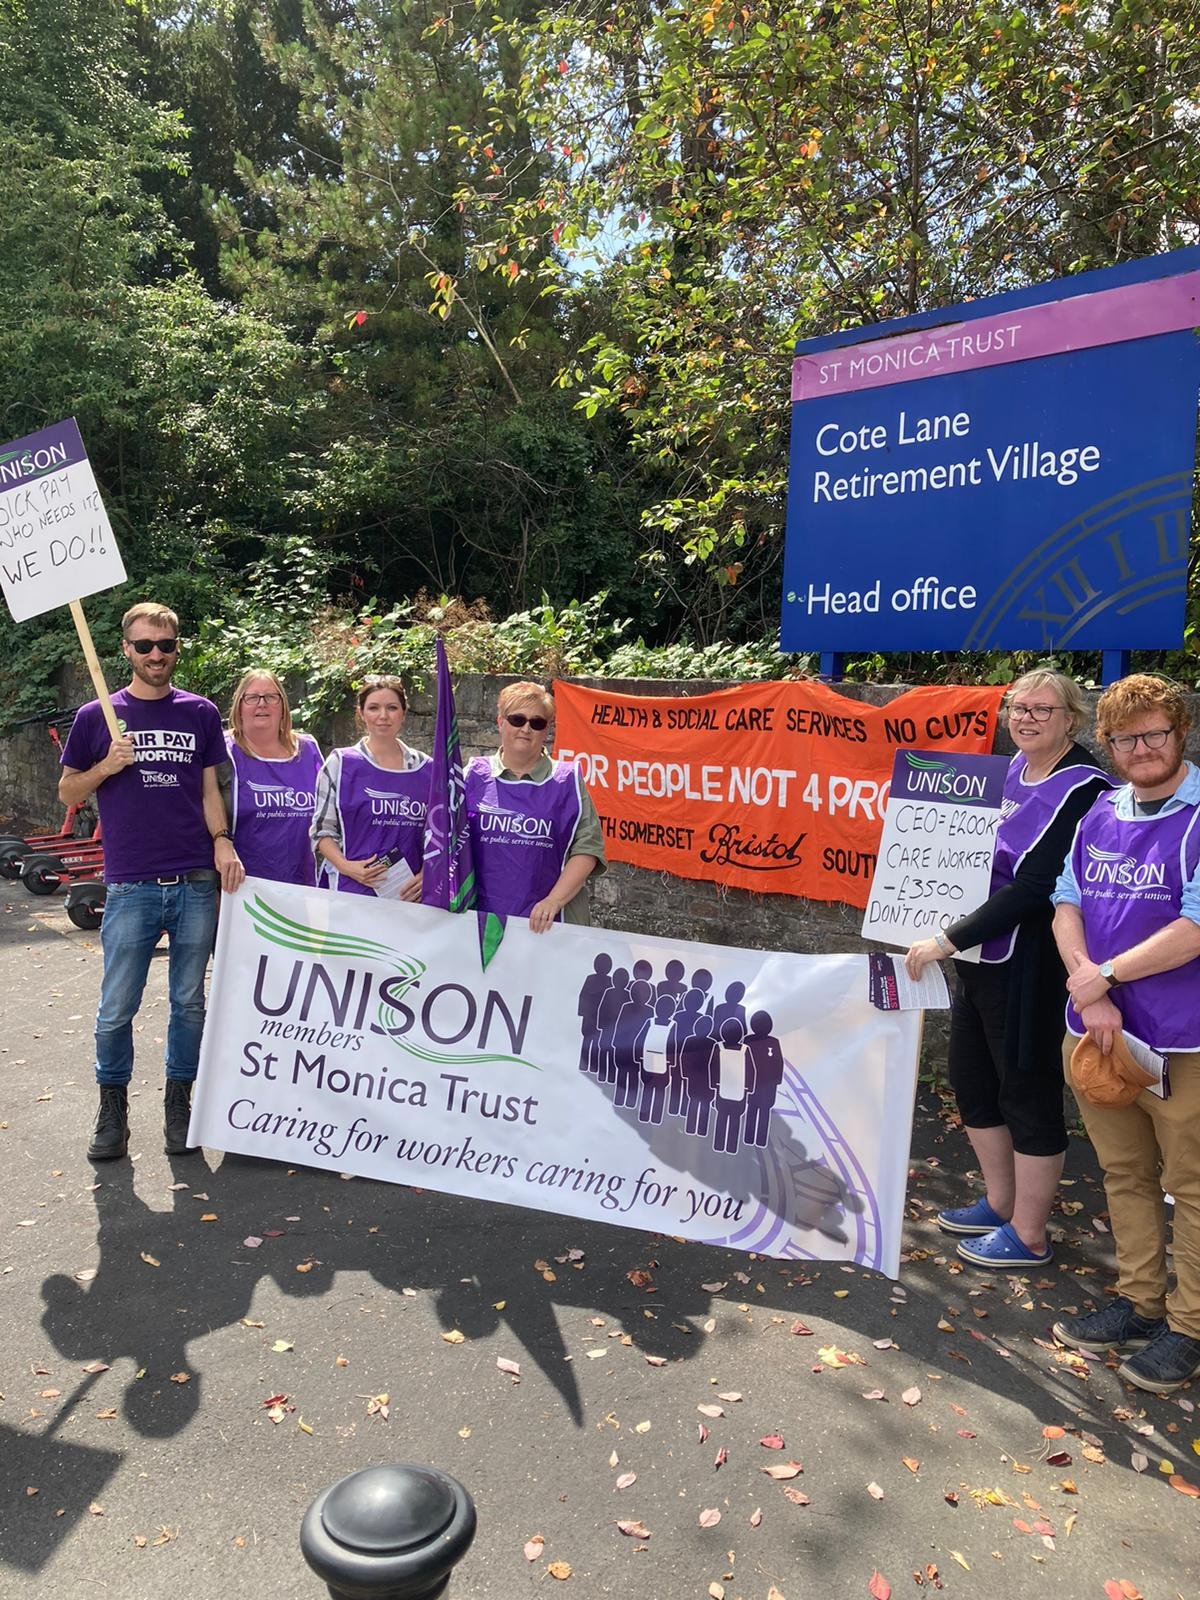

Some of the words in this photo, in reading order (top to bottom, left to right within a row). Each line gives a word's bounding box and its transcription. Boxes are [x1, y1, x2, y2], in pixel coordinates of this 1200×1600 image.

[818, 362, 843, 385] ST
[849, 345, 941, 379] MONICA
[945, 325, 1022, 359] TRUST
[815, 423, 888, 457] Cote
[898, 411, 971, 446] Lane
[0, 442, 67, 484] NISON
[813, 461, 982, 503] Retirement
[987, 441, 1101, 486] Village
[39, 472, 73, 502] PAY
[39, 502, 76, 531] NEEDS
[2, 551, 42, 585] WE
[50, 525, 107, 567] DO!!
[807, 580, 881, 615] Head
[891, 576, 977, 611] office
[163, 733, 193, 748] PAY
[591, 704, 648, 728] HEALTH
[652, 711, 663, 728] &
[725, 708, 775, 732] CARE
[786, 708, 868, 743] SERVICES
[884, 718, 917, 744] NO
[925, 710, 989, 740] CUTS
[142, 773, 177, 783] UNISON
[617, 759, 724, 802] PEOPLE
[728, 767, 797, 808] NOT
[802, 773, 823, 812] 4
[906, 770, 988, 798] UNISON
[480, 814, 553, 836] UNISON
[619, 820, 695, 851] SOMERSET
[700, 823, 808, 871] Bristol
[886, 843, 932, 870] CARE
[938, 848, 992, 872] WORKER
[1085, 862, 1165, 885] UNISON
[870, 900, 913, 926] DON'T
[913, 908, 939, 928] CUT
[1144, 891, 1171, 901] union
[253, 955, 533, 1055] UNISON
[260, 1019, 364, 1051] members
[240, 1042, 278, 1079] St
[292, 1050, 427, 1107] Monica
[440, 1073, 539, 1125] Trust
[228, 1099, 338, 1156] Caring
[336, 1118, 389, 1159] for
[397, 1137, 519, 1180] workers
[525, 1158, 626, 1210] caring
[619, 1168, 678, 1212] for
[680, 1188, 745, 1223] you
